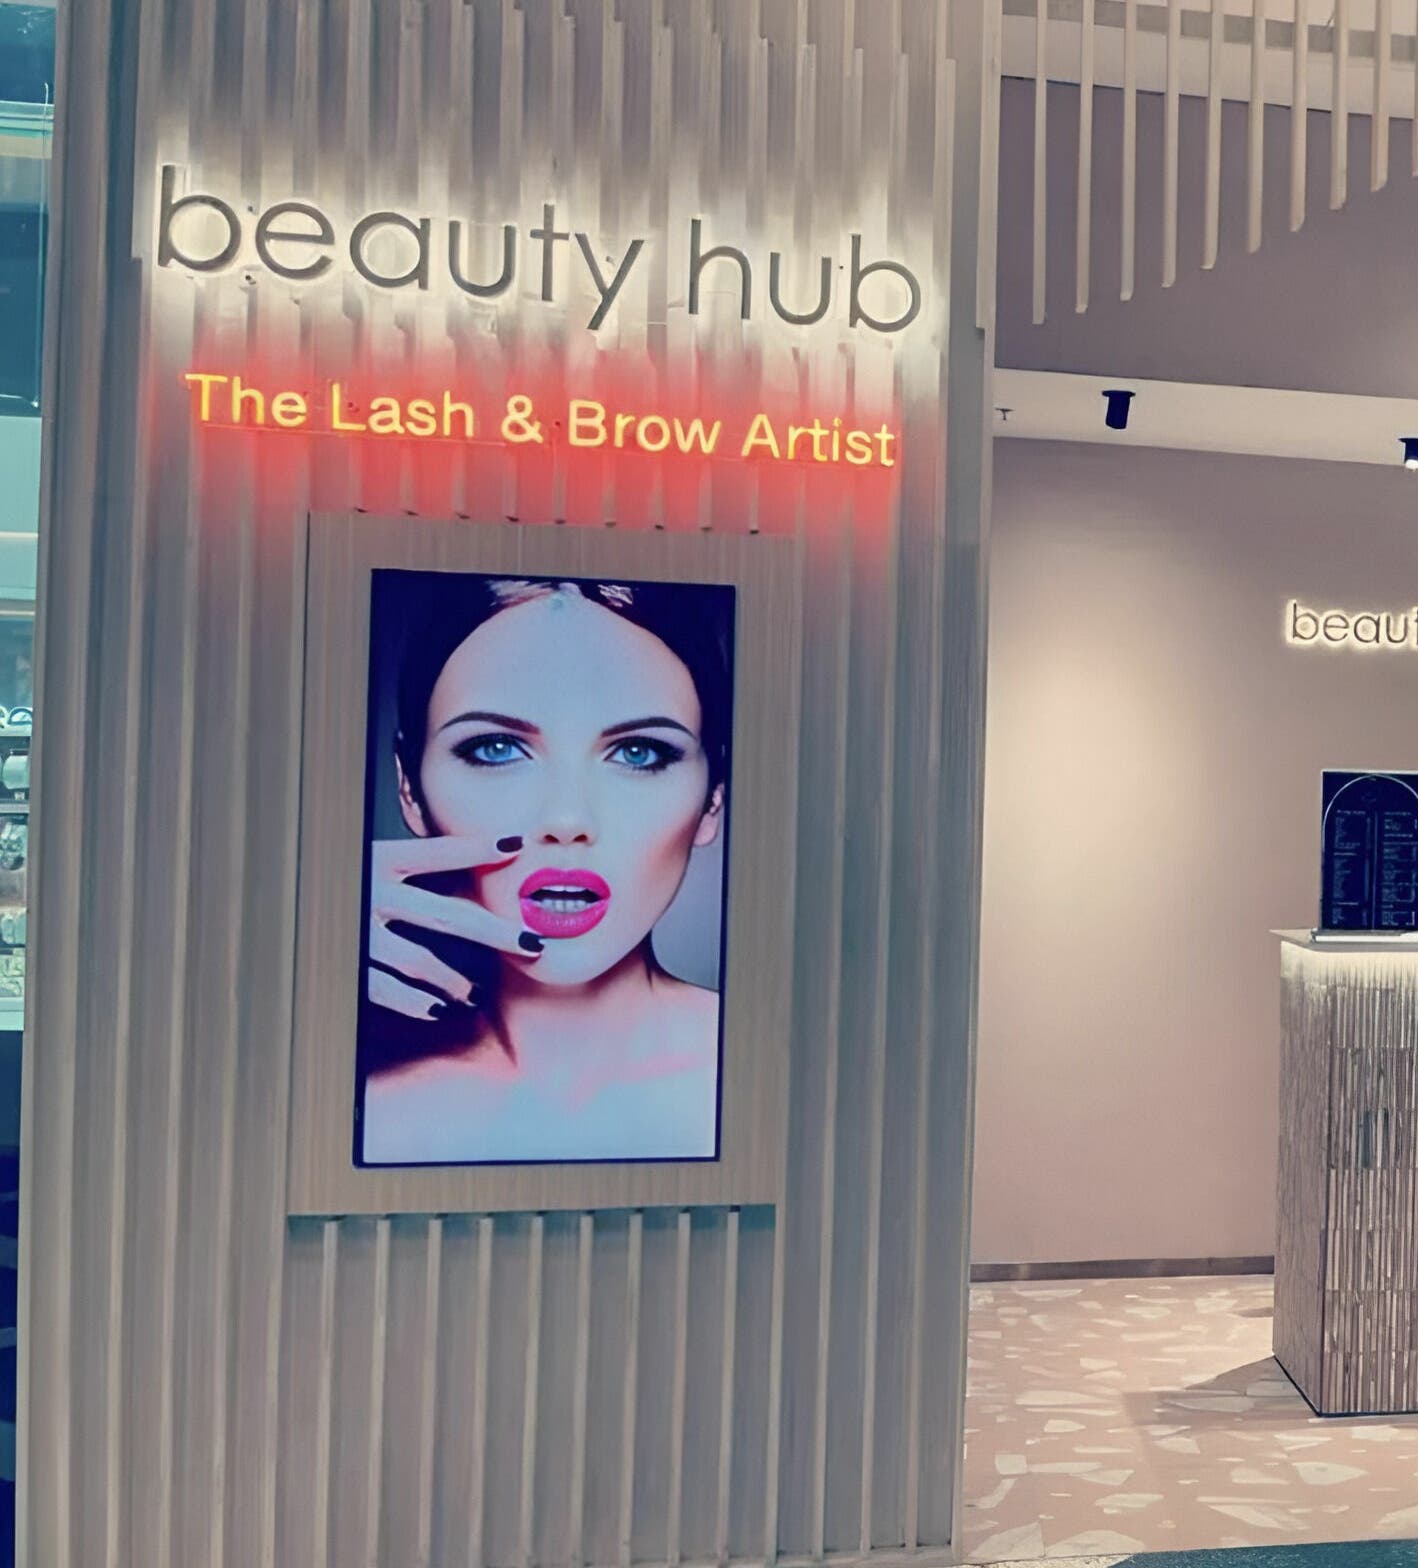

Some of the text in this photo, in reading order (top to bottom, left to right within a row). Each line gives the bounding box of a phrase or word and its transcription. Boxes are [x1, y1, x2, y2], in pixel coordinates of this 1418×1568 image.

[158, 163, 922, 333] beauty hub
[185, 373, 896, 468] The Lash & Brow Artist
